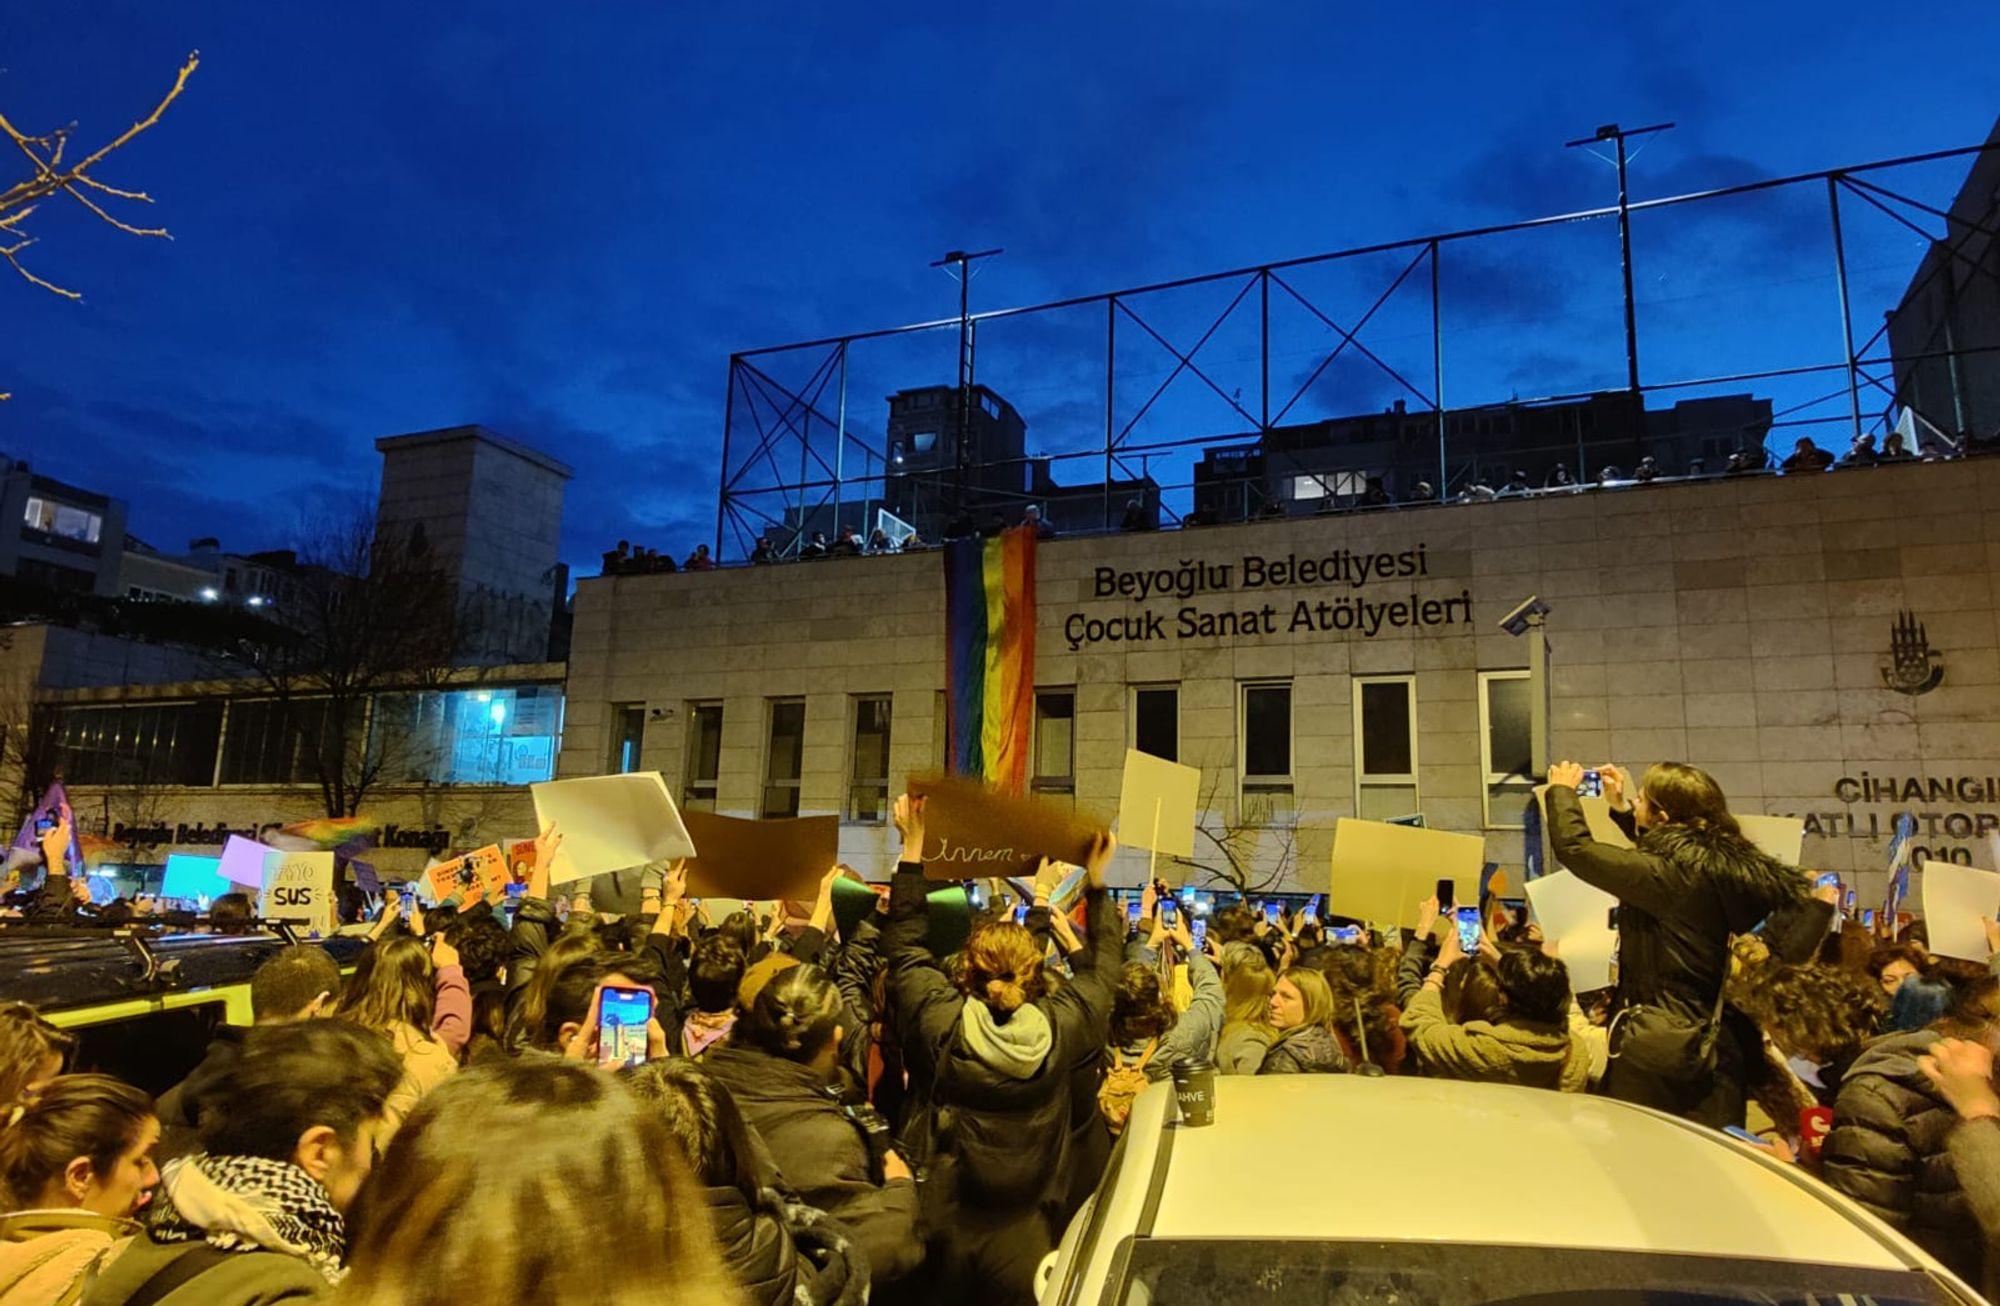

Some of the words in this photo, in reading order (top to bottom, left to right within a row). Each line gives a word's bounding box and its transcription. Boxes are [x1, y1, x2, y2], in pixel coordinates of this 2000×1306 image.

[1095, 559, 1233, 602] Beyoğlu
[1243, 543, 1428, 588] Belediyesi
[1065, 609, 1166, 651] Çocuk
[1177, 604, 1276, 639] Sanat
[1288, 590, 1472, 637] Atölyeleri
[1771, 812, 1879, 839] ATLI
[274, 886, 312, 906] SUS
